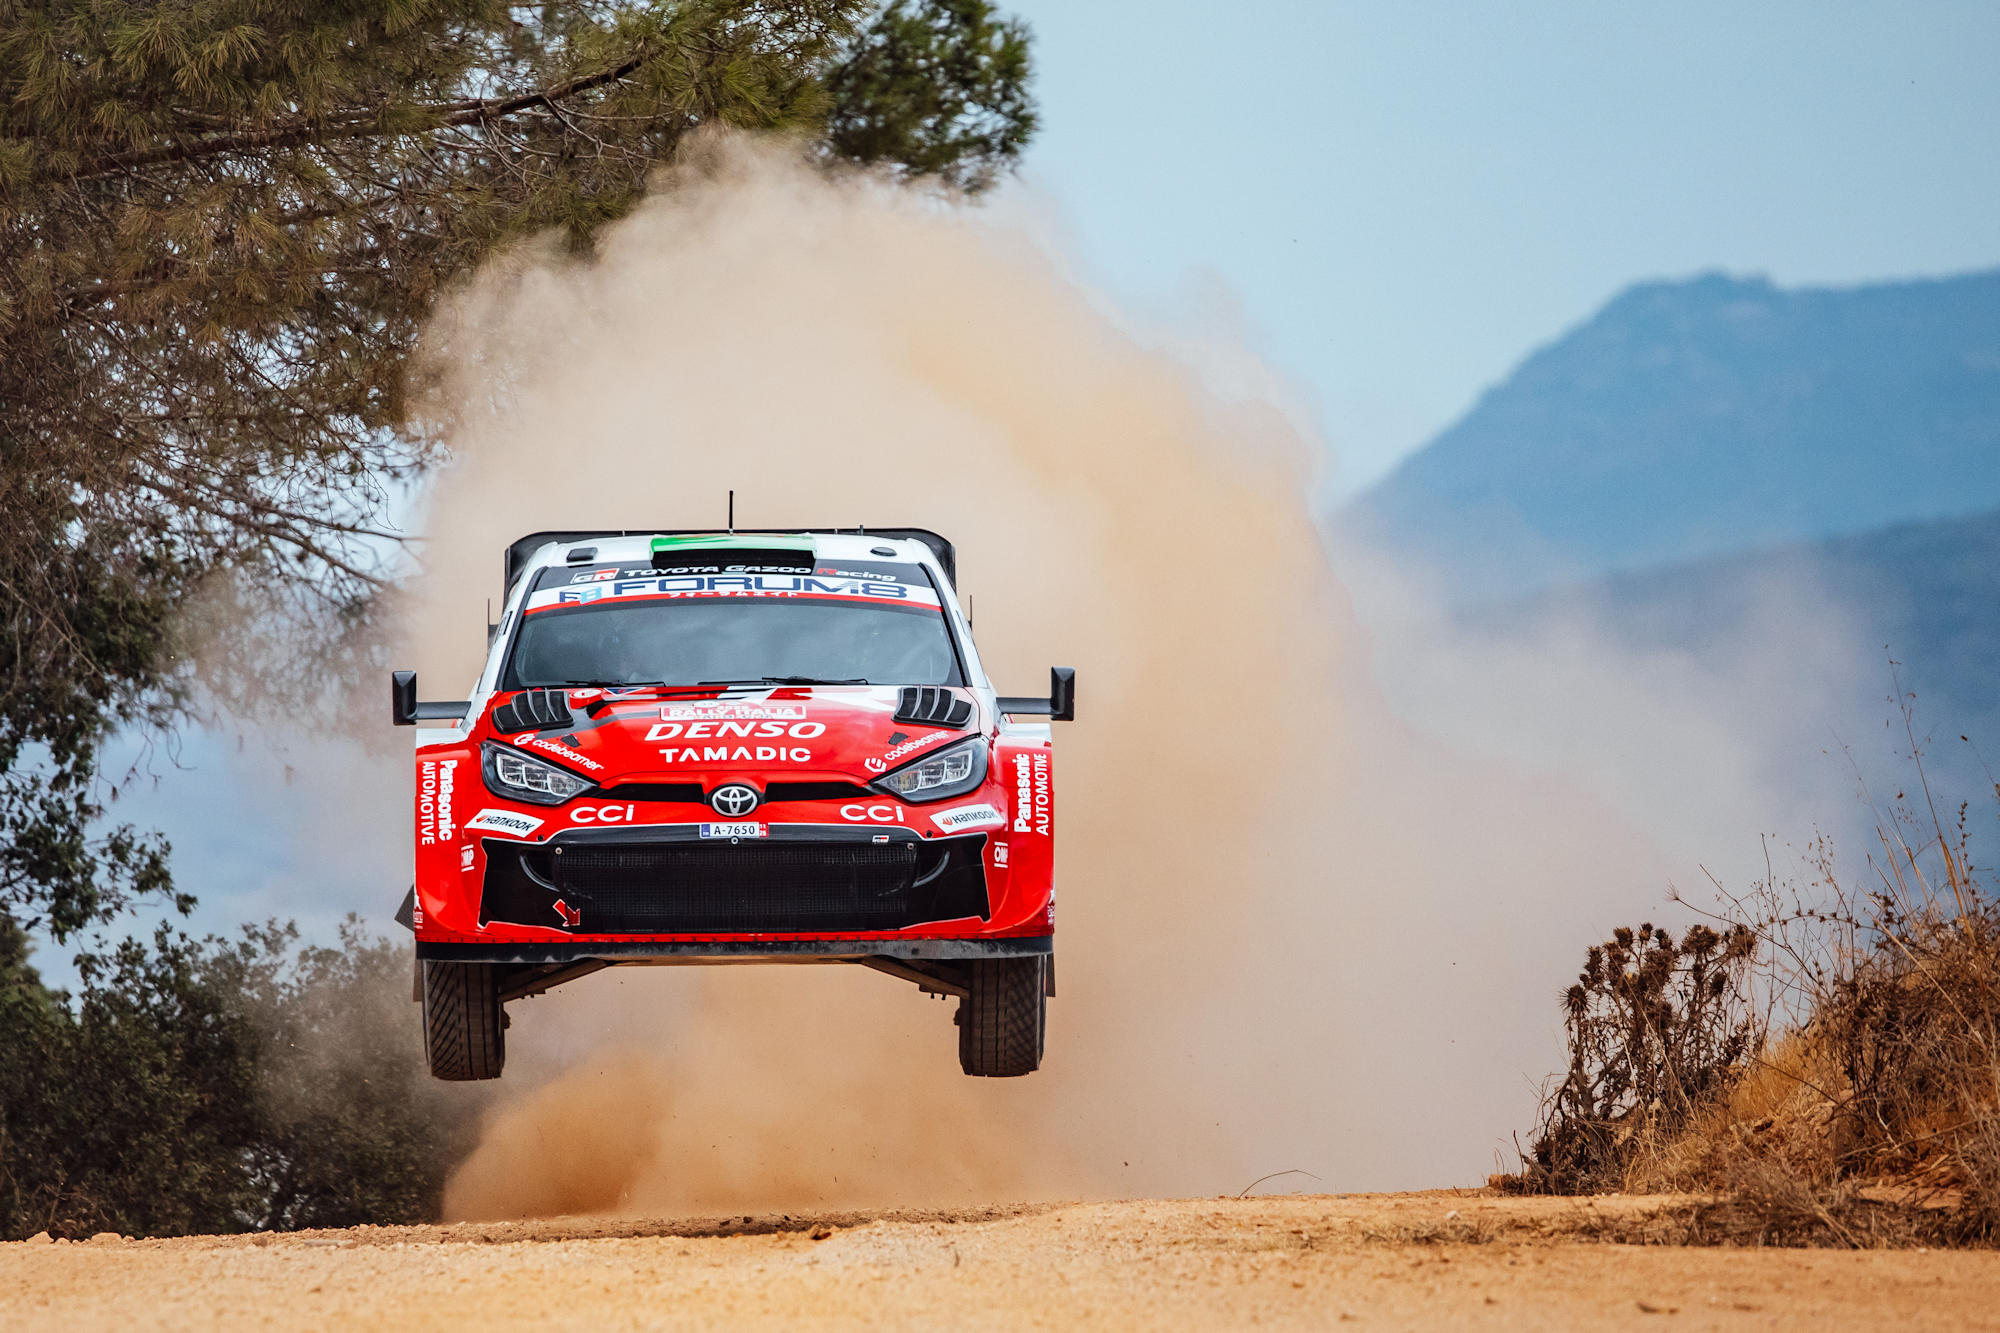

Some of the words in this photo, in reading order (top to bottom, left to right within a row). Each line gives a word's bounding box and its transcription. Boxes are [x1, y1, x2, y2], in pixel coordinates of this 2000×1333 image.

[614, 576, 907, 598] FORUM8
[624, 567, 719, 577] TOYOTA
[725, 565, 811, 574] GAZOO
[817, 568, 896, 582] Racing
[644, 721, 827, 741] DENSO
[884, 730, 949, 760] codebeamer
[532, 739, 604, 770] codebeamer
[659, 746, 811, 763] TAMADIC
[420, 761, 436, 845] AUTOMOTIVE
[437, 760, 457, 841] Panasonic
[1013, 753, 1032, 833] Panasonic
[1034, 753, 1049, 836] AUTOMOTIVE
[714, 825, 755, 835] A-7650
